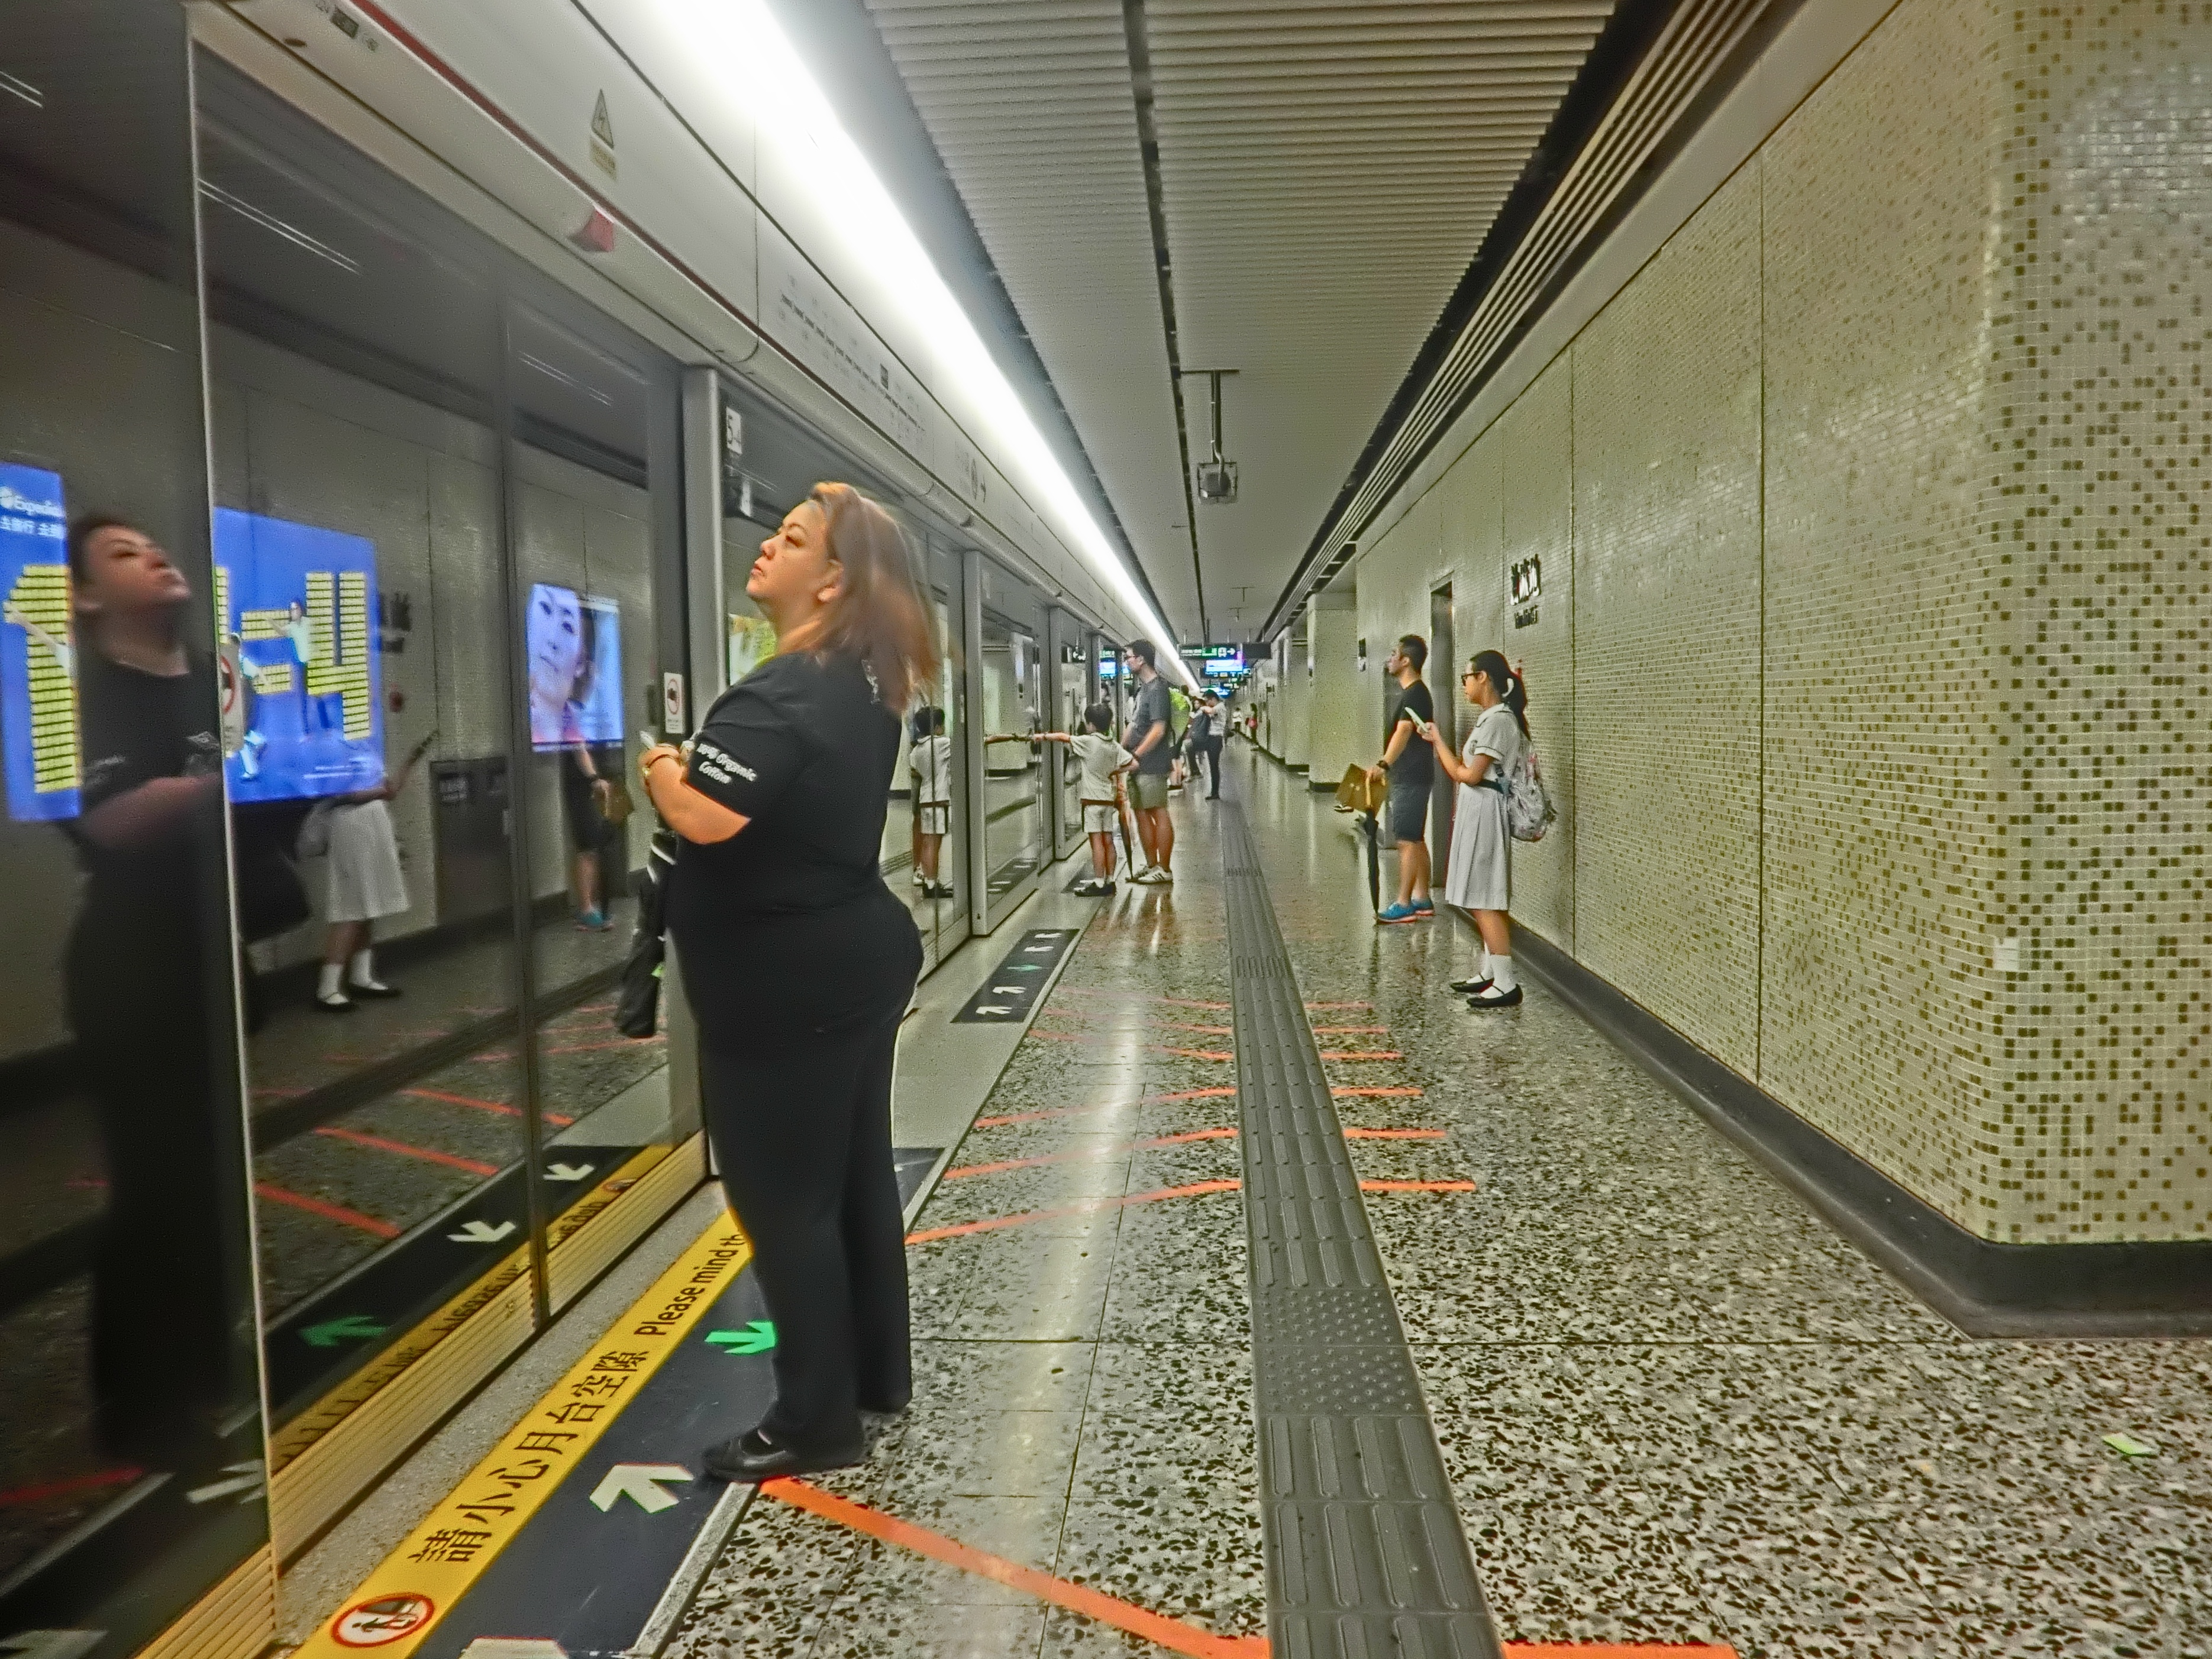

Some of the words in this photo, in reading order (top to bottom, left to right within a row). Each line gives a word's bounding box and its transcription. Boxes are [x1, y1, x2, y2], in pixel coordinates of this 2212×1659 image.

[699, 761, 732, 784] Cotton
[715, 753, 757, 782] Organic
[634, 1287, 705, 1335] Please
[690, 1250, 739, 1283] mind
[407, 1351, 650, 1563] 請小心月台空隙
